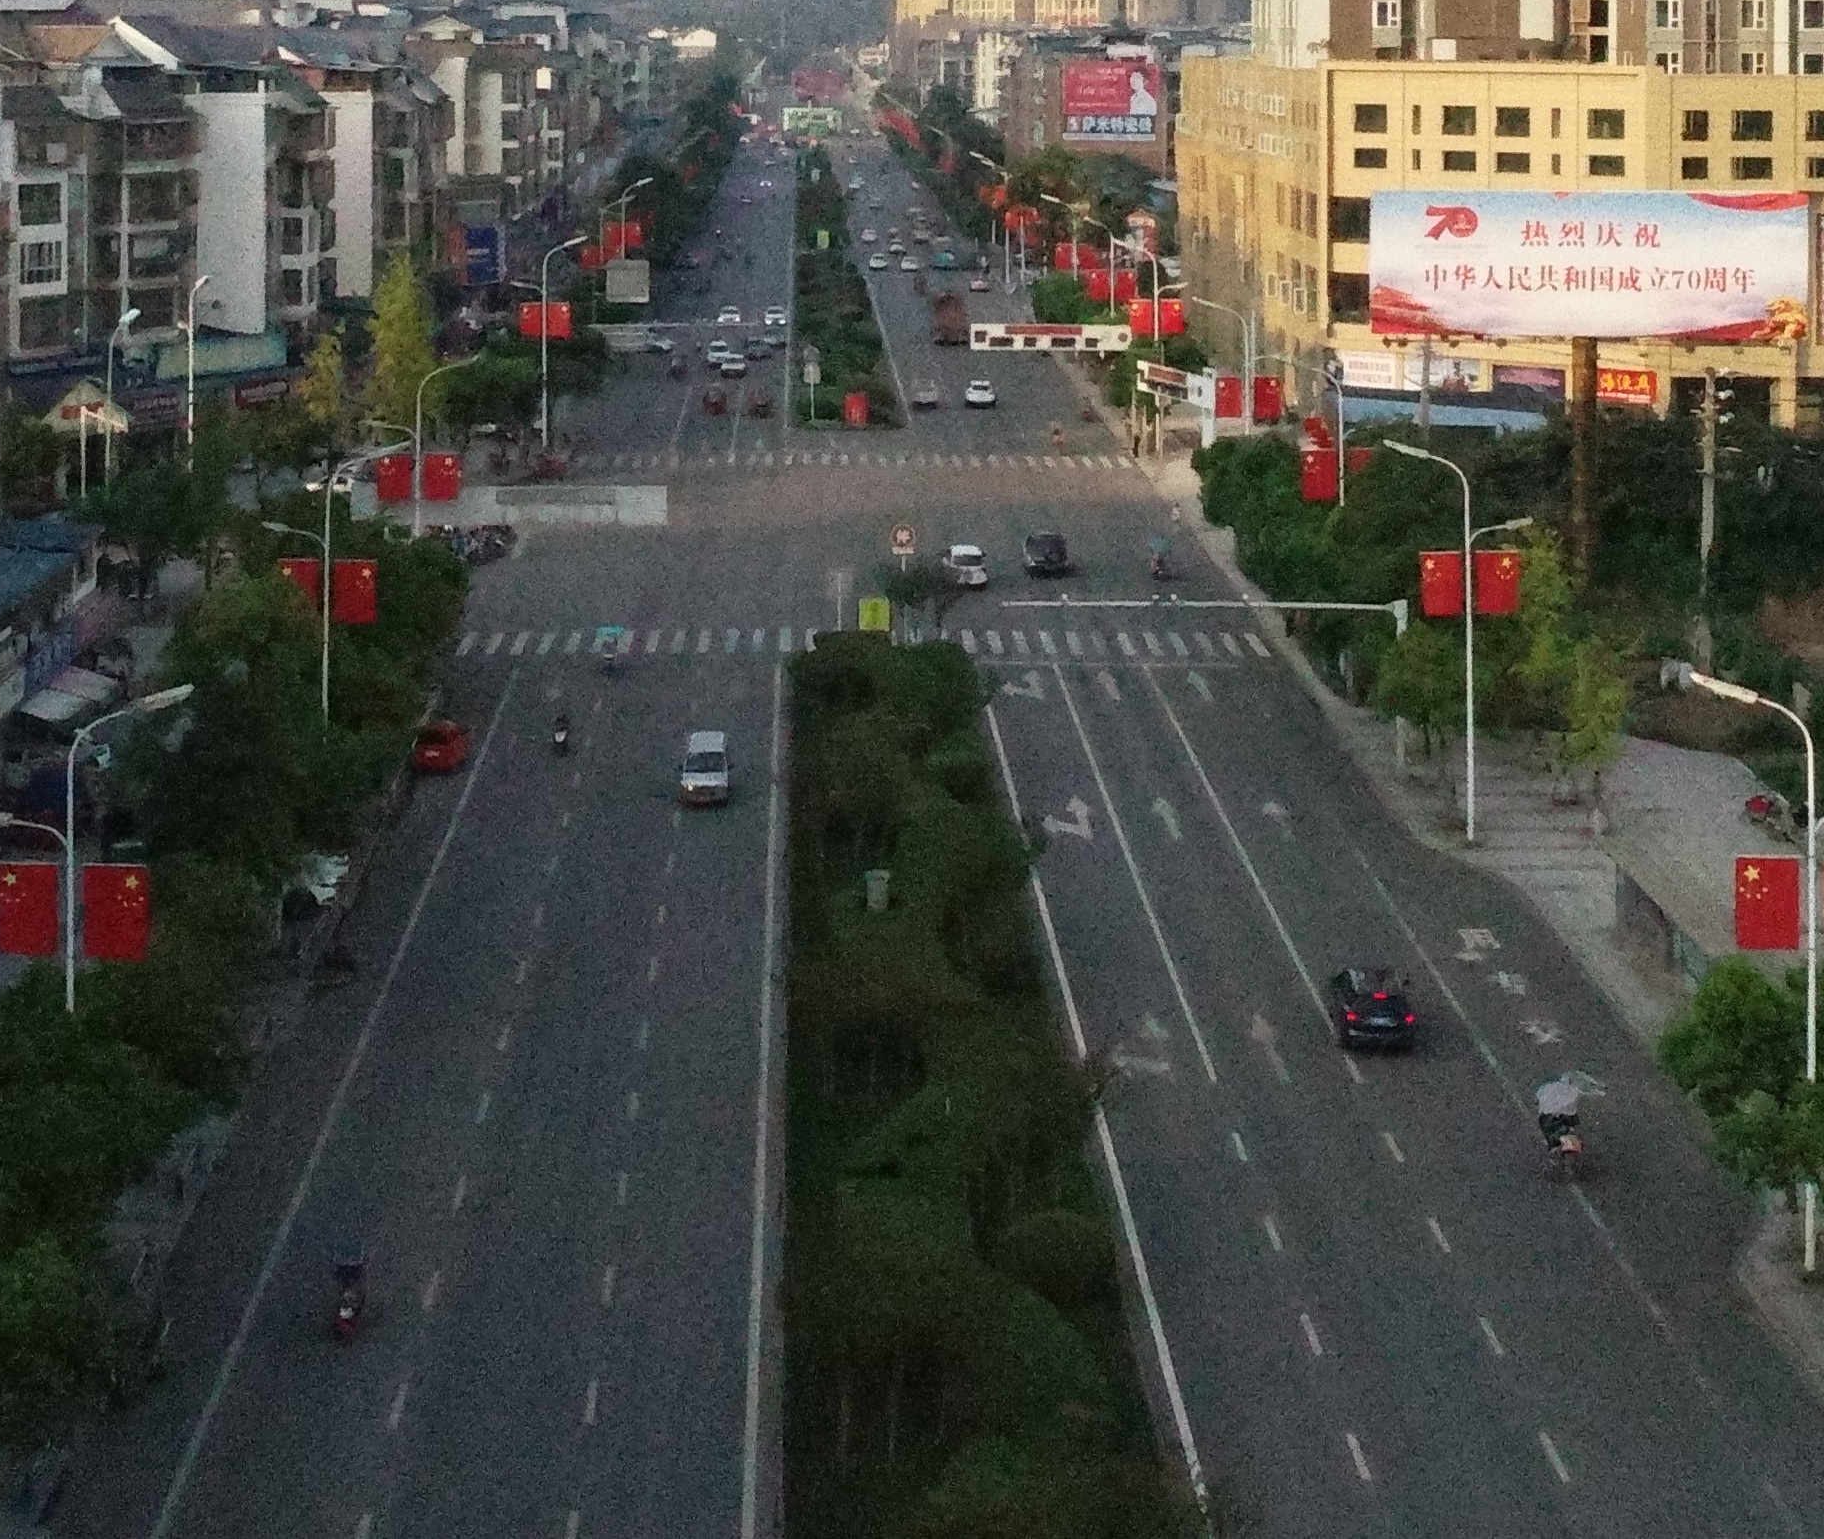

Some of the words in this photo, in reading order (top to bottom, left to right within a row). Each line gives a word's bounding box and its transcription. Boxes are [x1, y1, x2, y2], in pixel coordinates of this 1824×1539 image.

[1520, 220, 1661, 248] 热烈庆祝
[1425, 264, 1756, 294] 中华人民共和国成立70周年
